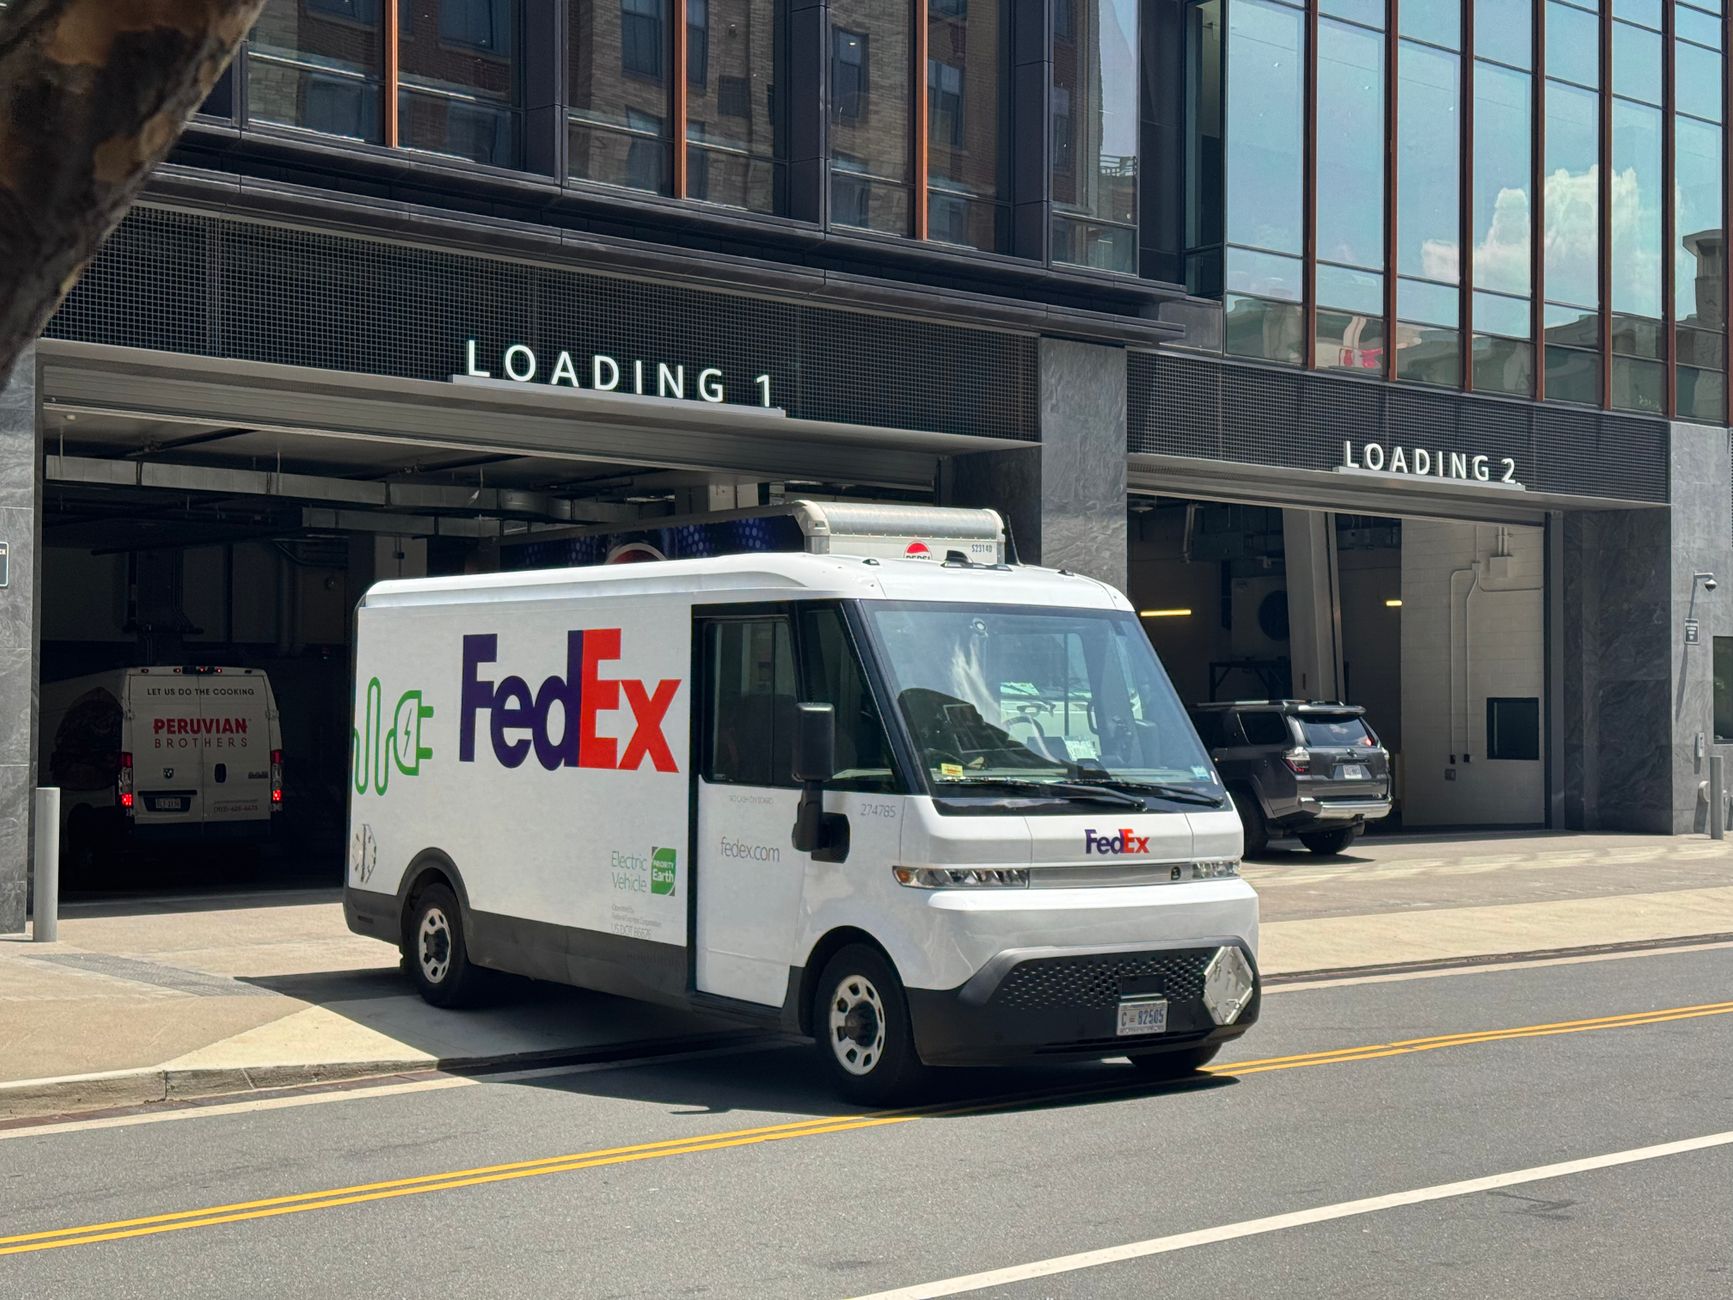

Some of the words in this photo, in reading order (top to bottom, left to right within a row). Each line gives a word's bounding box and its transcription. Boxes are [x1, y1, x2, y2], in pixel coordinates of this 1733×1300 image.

[466, 340, 724, 402] LOADING
[754, 374, 770, 407] 1
[1345, 440, 1490, 482] LOADING
[1501, 457, 1516, 484] 2
[147, 688, 161, 696] LET
[164, 688, 175, 696] US
[178, 688, 192, 696] DO
[195, 688, 210, 696] THE
[212, 688, 255, 696] COOKING
[459, 628, 682, 773] FedEx
[153, 718, 248, 735] PERUVIAN
[154, 737, 248, 749] BROTHERS
[860, 803, 897, 818] 274785
[720, 836, 780, 862] fedex.com
[1084, 828, 1150, 855] FedEx
[611, 850, 648, 872] Electric
[611, 872, 647, 893] Vehicle
[652, 868, 674, 883] Earth
